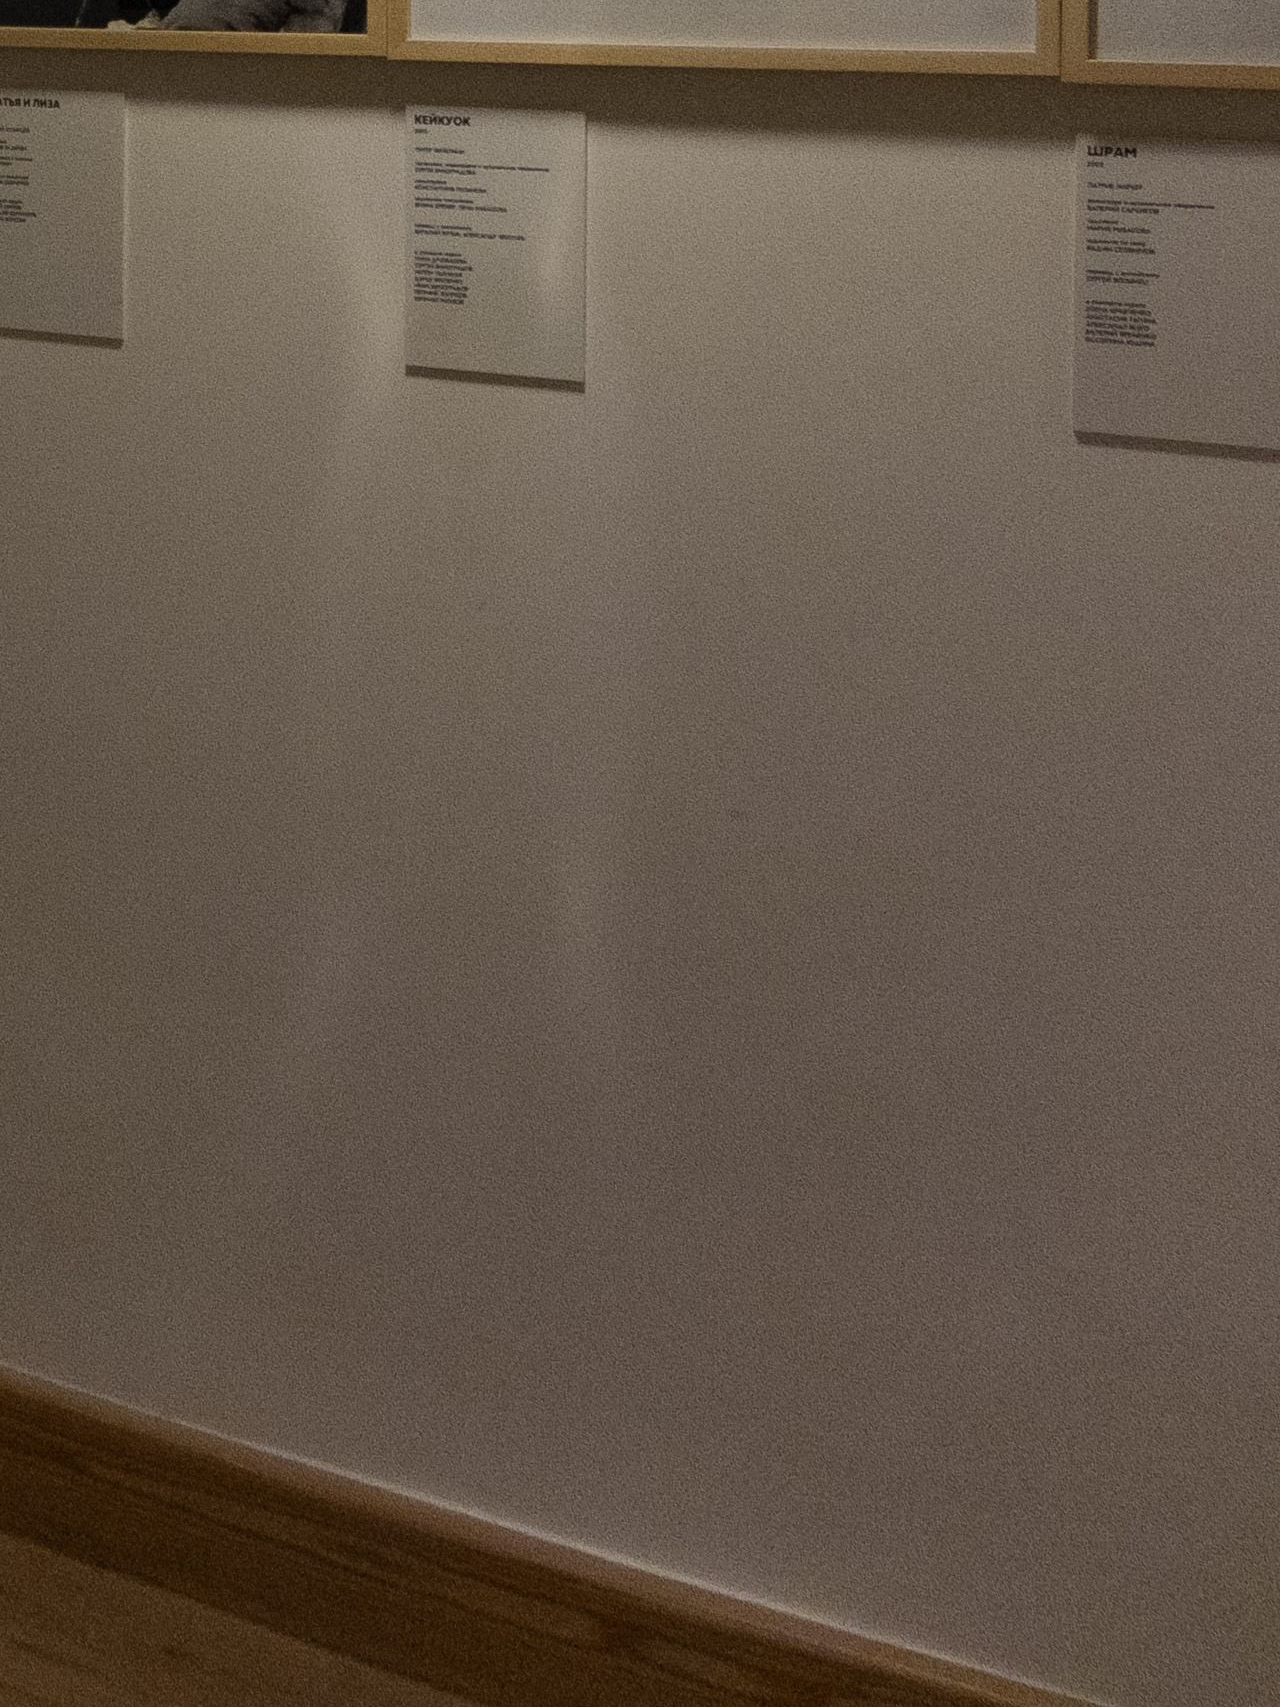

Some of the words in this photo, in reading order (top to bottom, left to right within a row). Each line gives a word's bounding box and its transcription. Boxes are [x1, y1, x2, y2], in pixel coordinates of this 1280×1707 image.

[23, 98, 31, 107] И
[33, 98, 60, 109] ЛИЗА
[415, 113, 471, 127] КЕЙКУОК
[1087, 145, 1137, 158] ШРАМ
